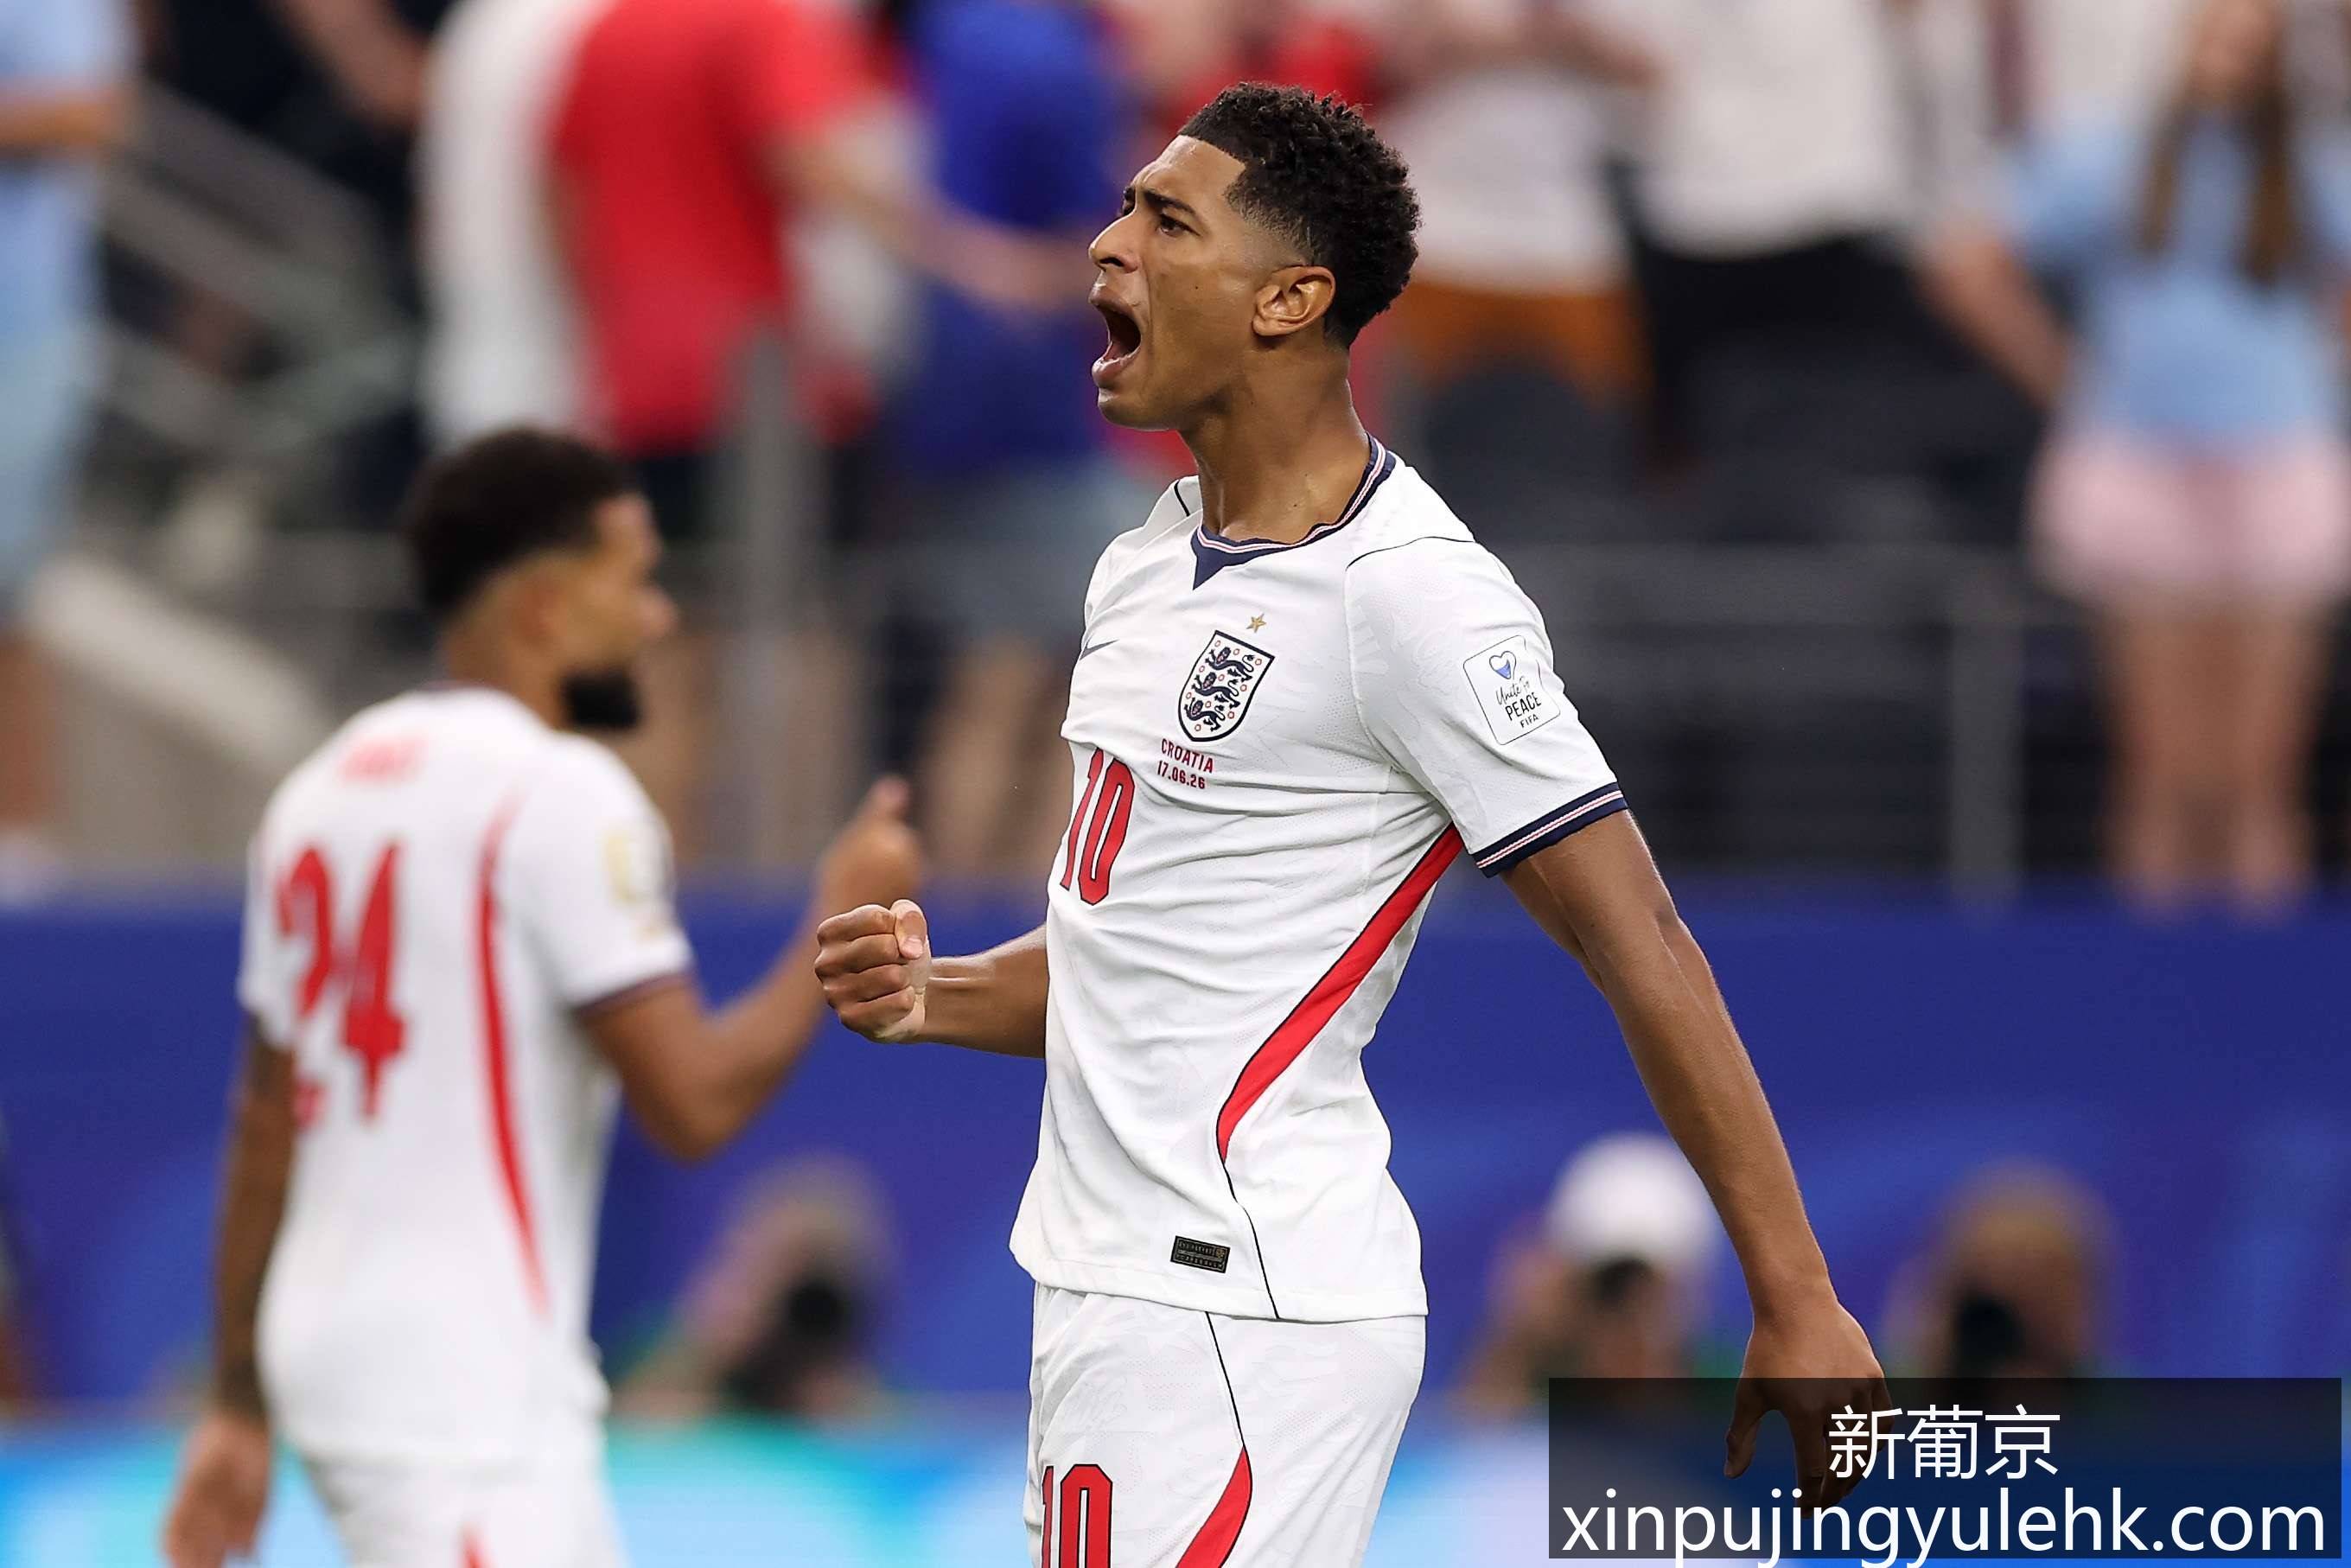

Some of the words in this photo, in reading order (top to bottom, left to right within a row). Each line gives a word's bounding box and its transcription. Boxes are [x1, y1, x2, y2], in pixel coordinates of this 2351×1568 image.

[1505, 692, 1542, 721] PEACE
[1520, 713, 1539, 728] FIFA
[1162, 738, 1214, 774] CROATIA
[1157, 760, 1205, 789] 17.06.26
[1060, 747, 1135, 905] 10
[275, 838, 408, 1131] 24
[1042, 1463, 1113, 1568] 10
